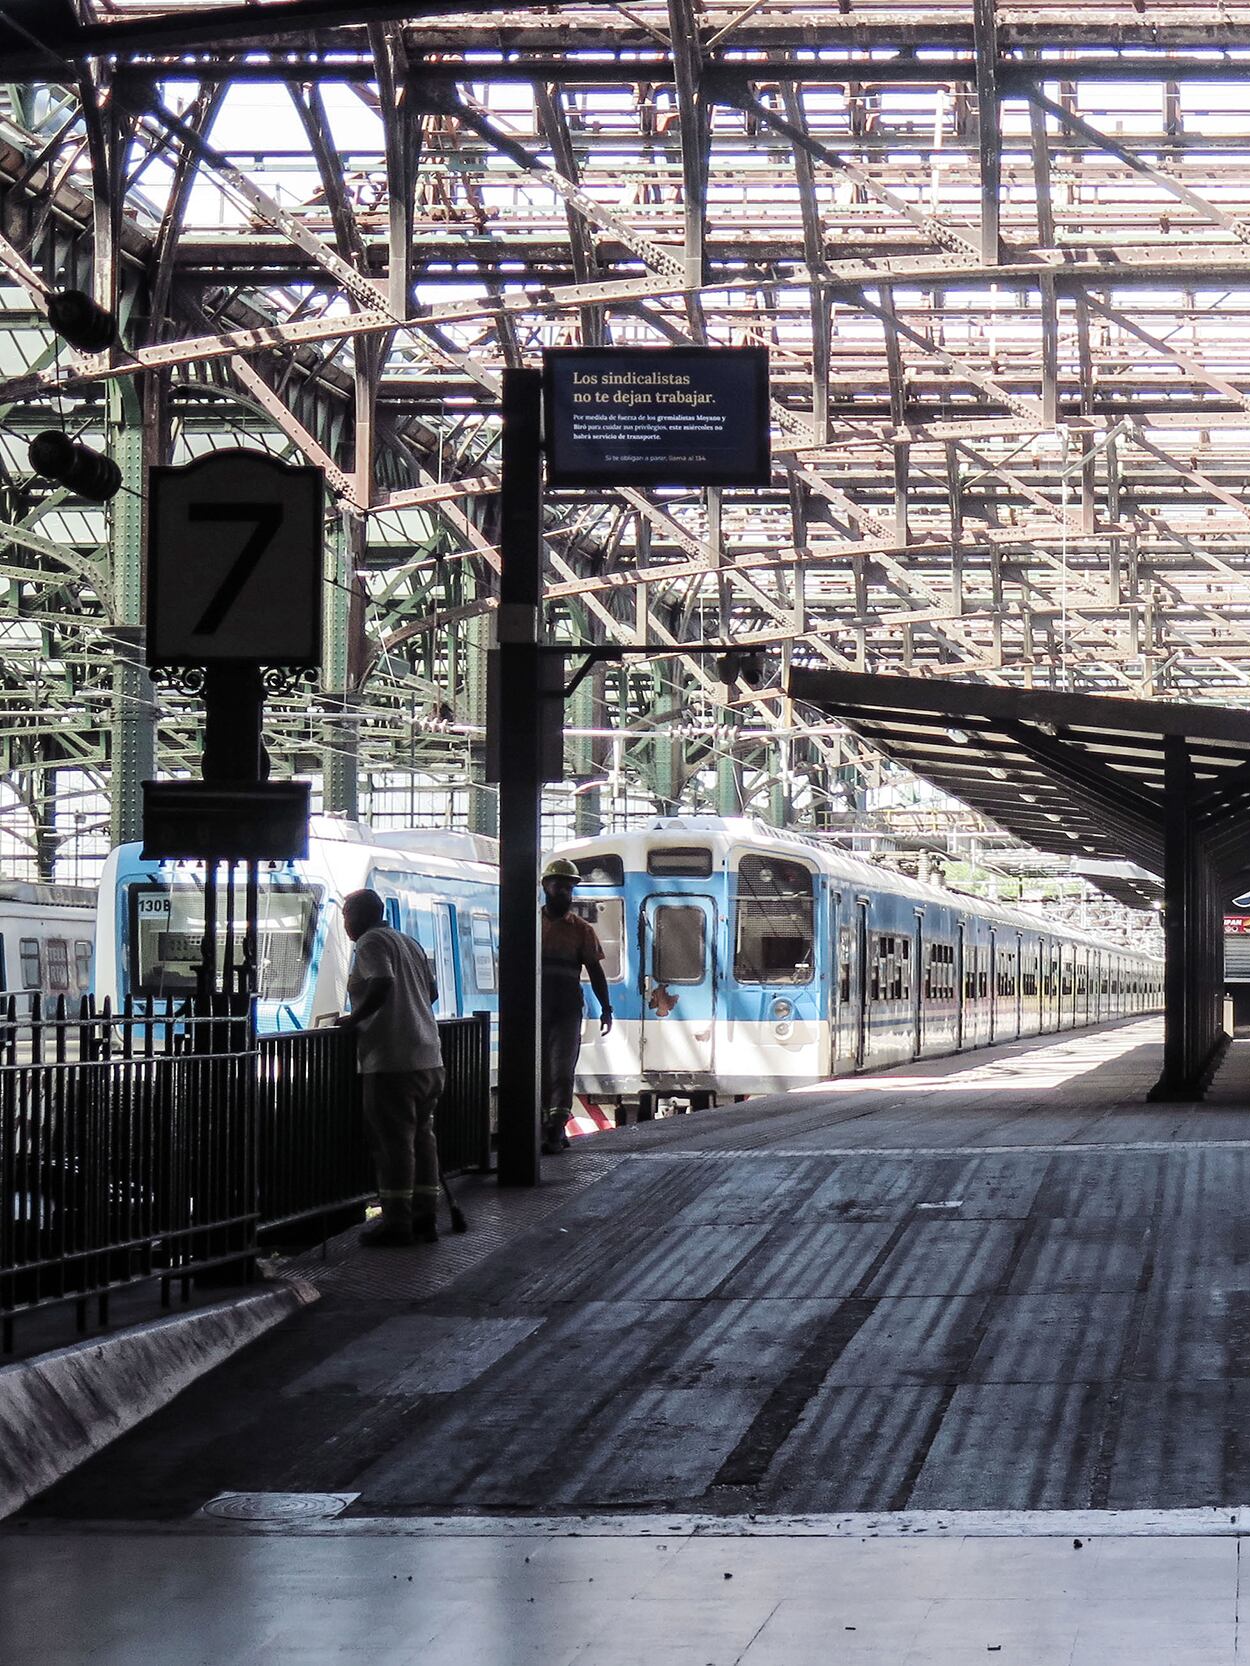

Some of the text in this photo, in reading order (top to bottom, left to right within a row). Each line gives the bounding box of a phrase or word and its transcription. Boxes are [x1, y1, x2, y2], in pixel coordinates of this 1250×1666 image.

[573, 372, 690, 385] Los sindicalistas
[574, 390, 716, 407] no te dejan trabajar.
[188, 502, 284, 635] 7
[139, 900, 171, 912] 130B
